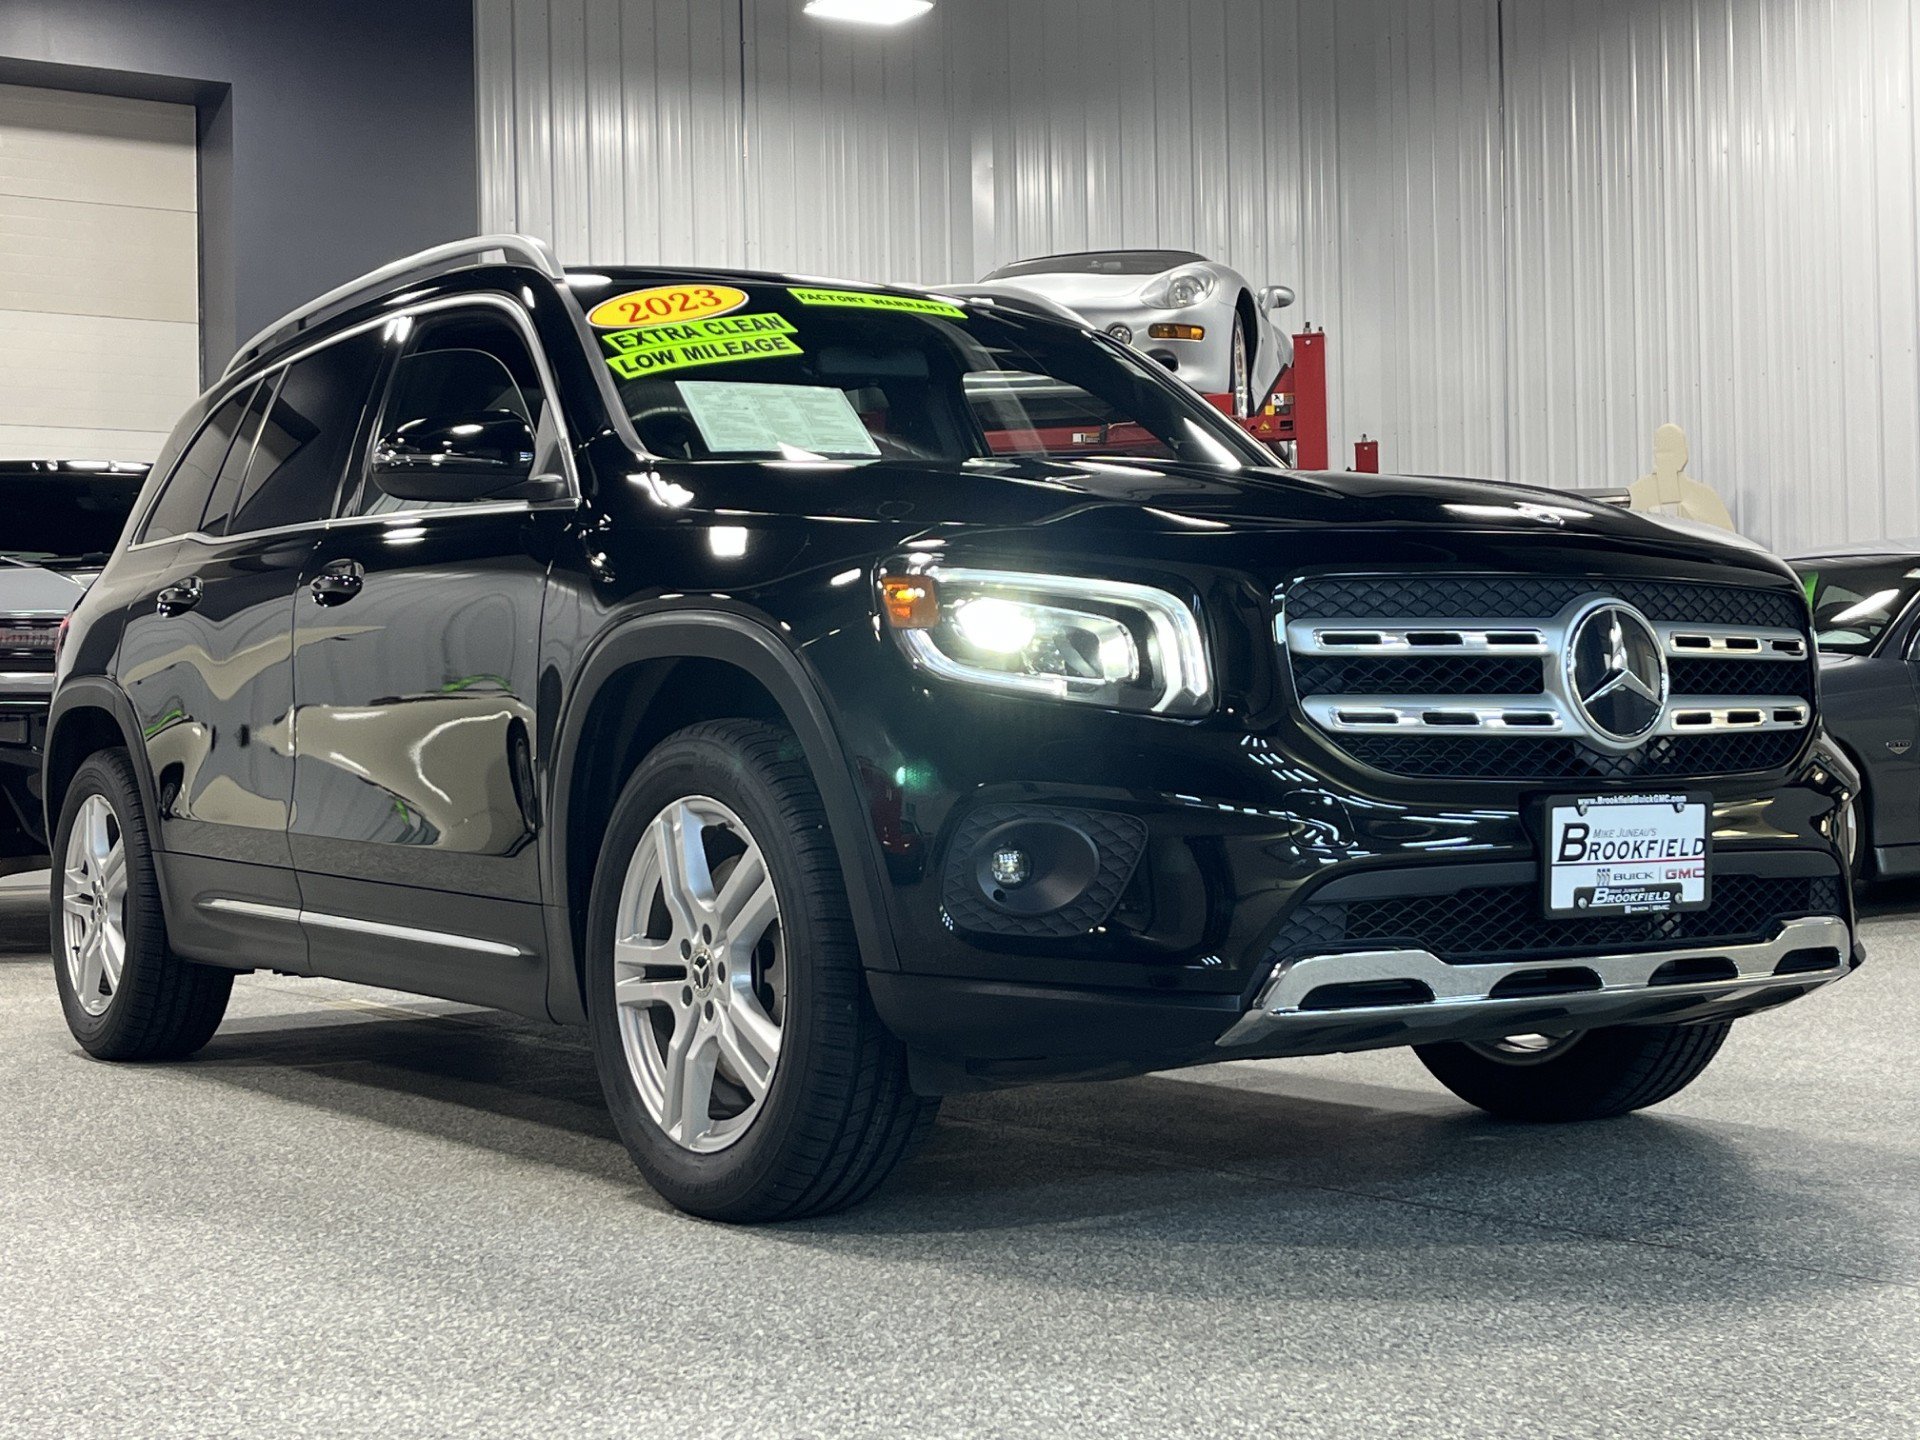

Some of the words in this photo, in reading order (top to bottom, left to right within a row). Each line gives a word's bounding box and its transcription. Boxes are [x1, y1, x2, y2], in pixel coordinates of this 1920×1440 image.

[618, 288, 722, 323] 2023
[797, 293, 865, 304] FACTORY
[870, 298, 957, 314] WARRANTY
[612, 325, 703, 350] EXTRA
[703, 316, 786, 335] CLEAN
[619, 349, 677, 373] LOW
[680, 336, 790, 361] MILEAGE
[1556, 822, 1705, 862] BROOKFIELD
[1593, 828, 1615, 838] MIKE
[1616, 828, 1657, 838] JUNEAU'S
[1613, 871, 1655, 881] BUICK
[1665, 868, 1705, 880] GMC
[1591, 887, 1671, 904] BROOKFIELD
